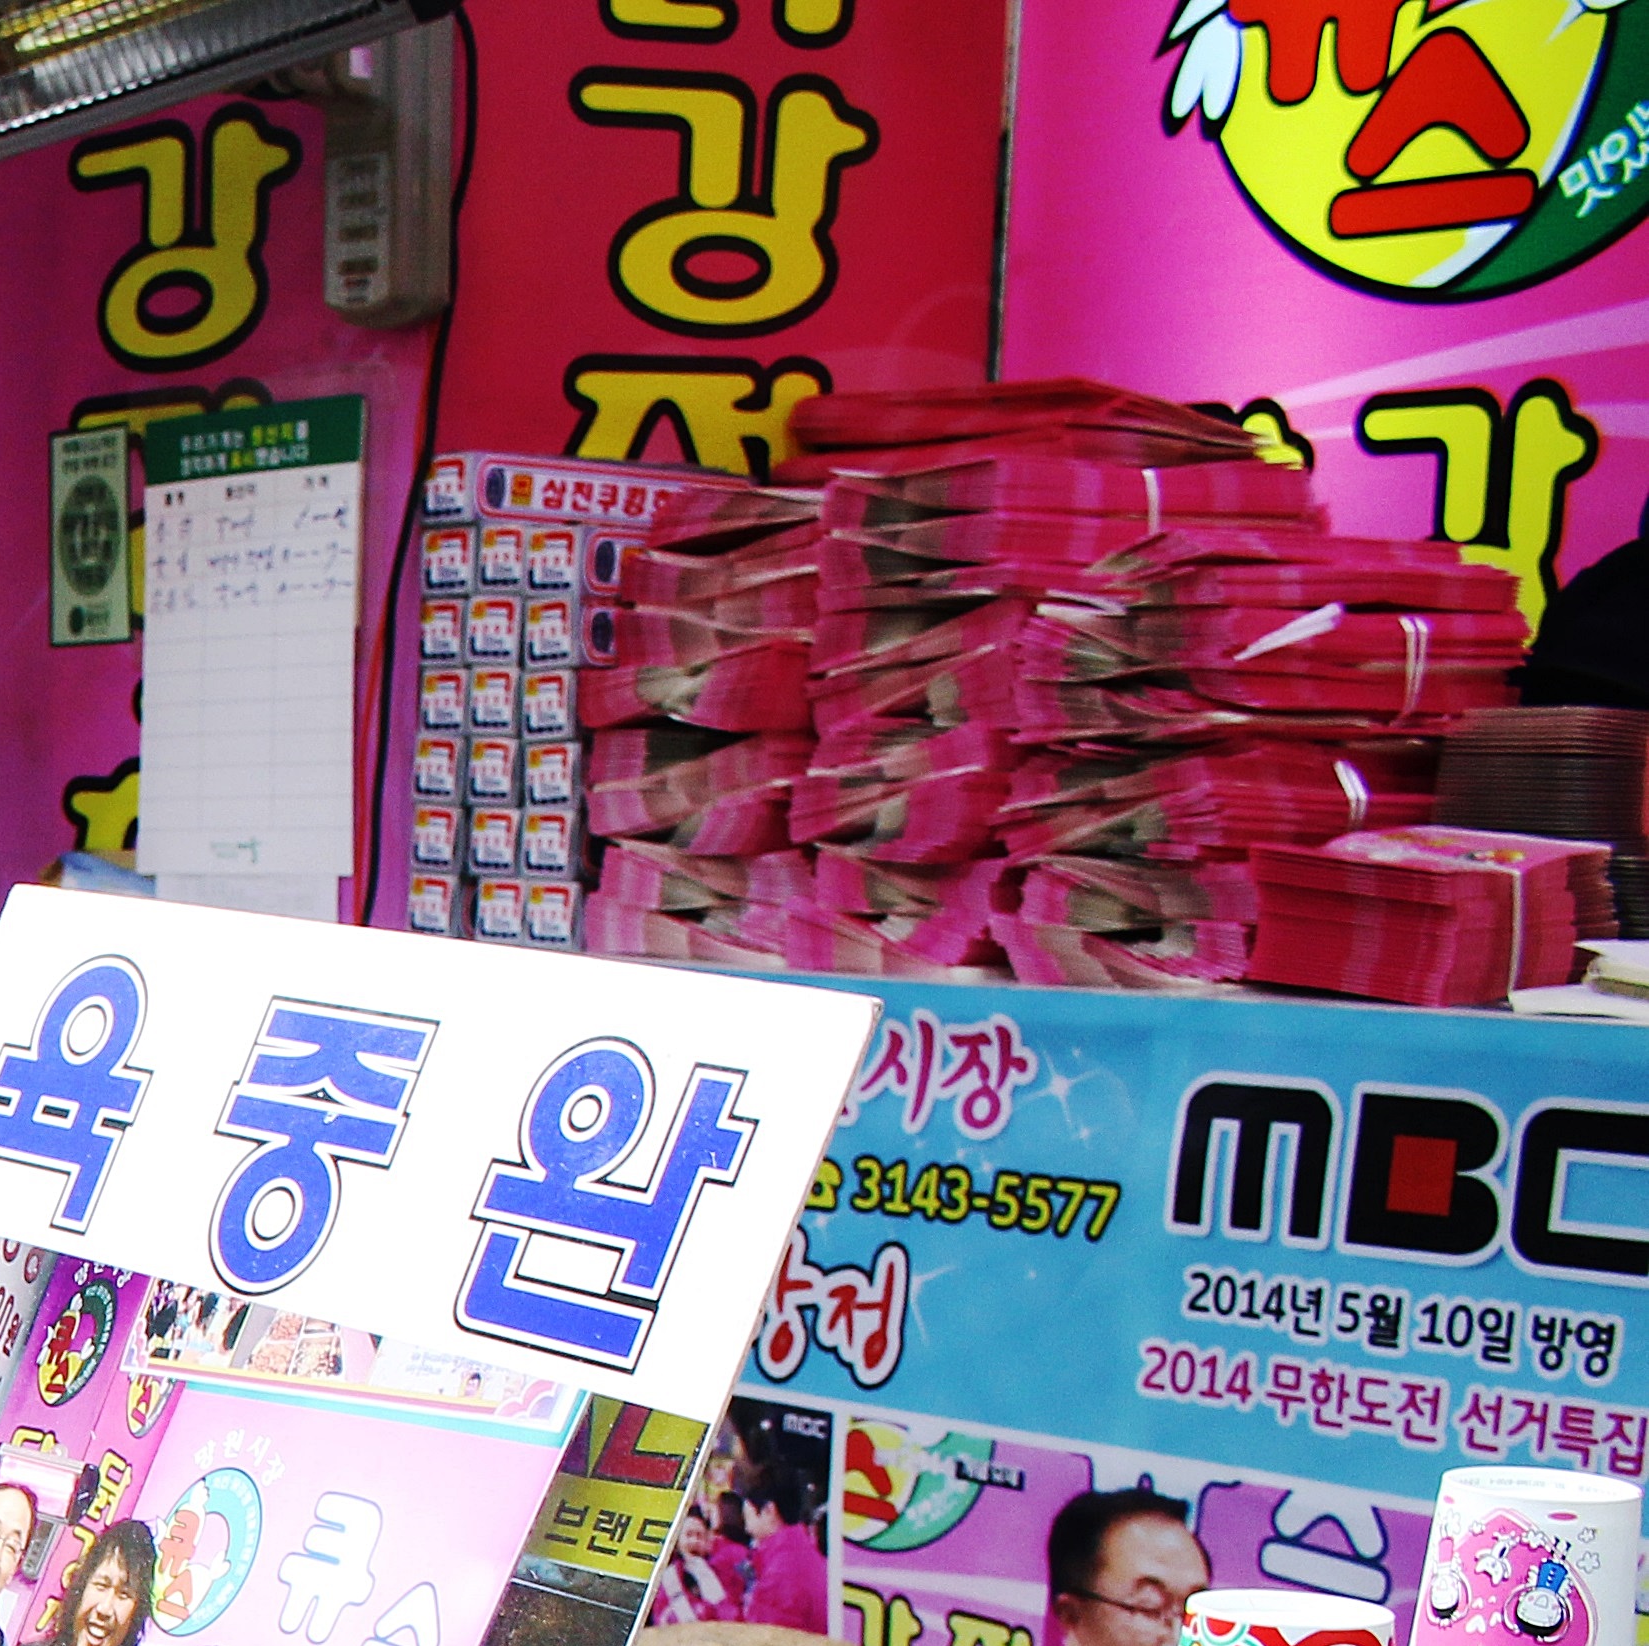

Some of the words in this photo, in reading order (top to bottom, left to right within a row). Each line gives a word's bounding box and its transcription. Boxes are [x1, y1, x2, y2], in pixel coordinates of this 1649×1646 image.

[839, 1014, 1031, 1132] 시장
[851, 1155, 1122, 1244] 3143-5577
[1169, 1078, 1649, 1280] MBC
[1187, 1271, 1323, 1336] 2014년
[1336, 1290, 1403, 1350] 5월
[1418, 1302, 1516, 1364] 10일
[1530, 1313, 1616, 1378] 방영
[1141, 1345, 1253, 1402] 2014
[1265, 1362, 1442, 1445] 무한도전
[1459, 1393, 1649, 1478] 선거특집
